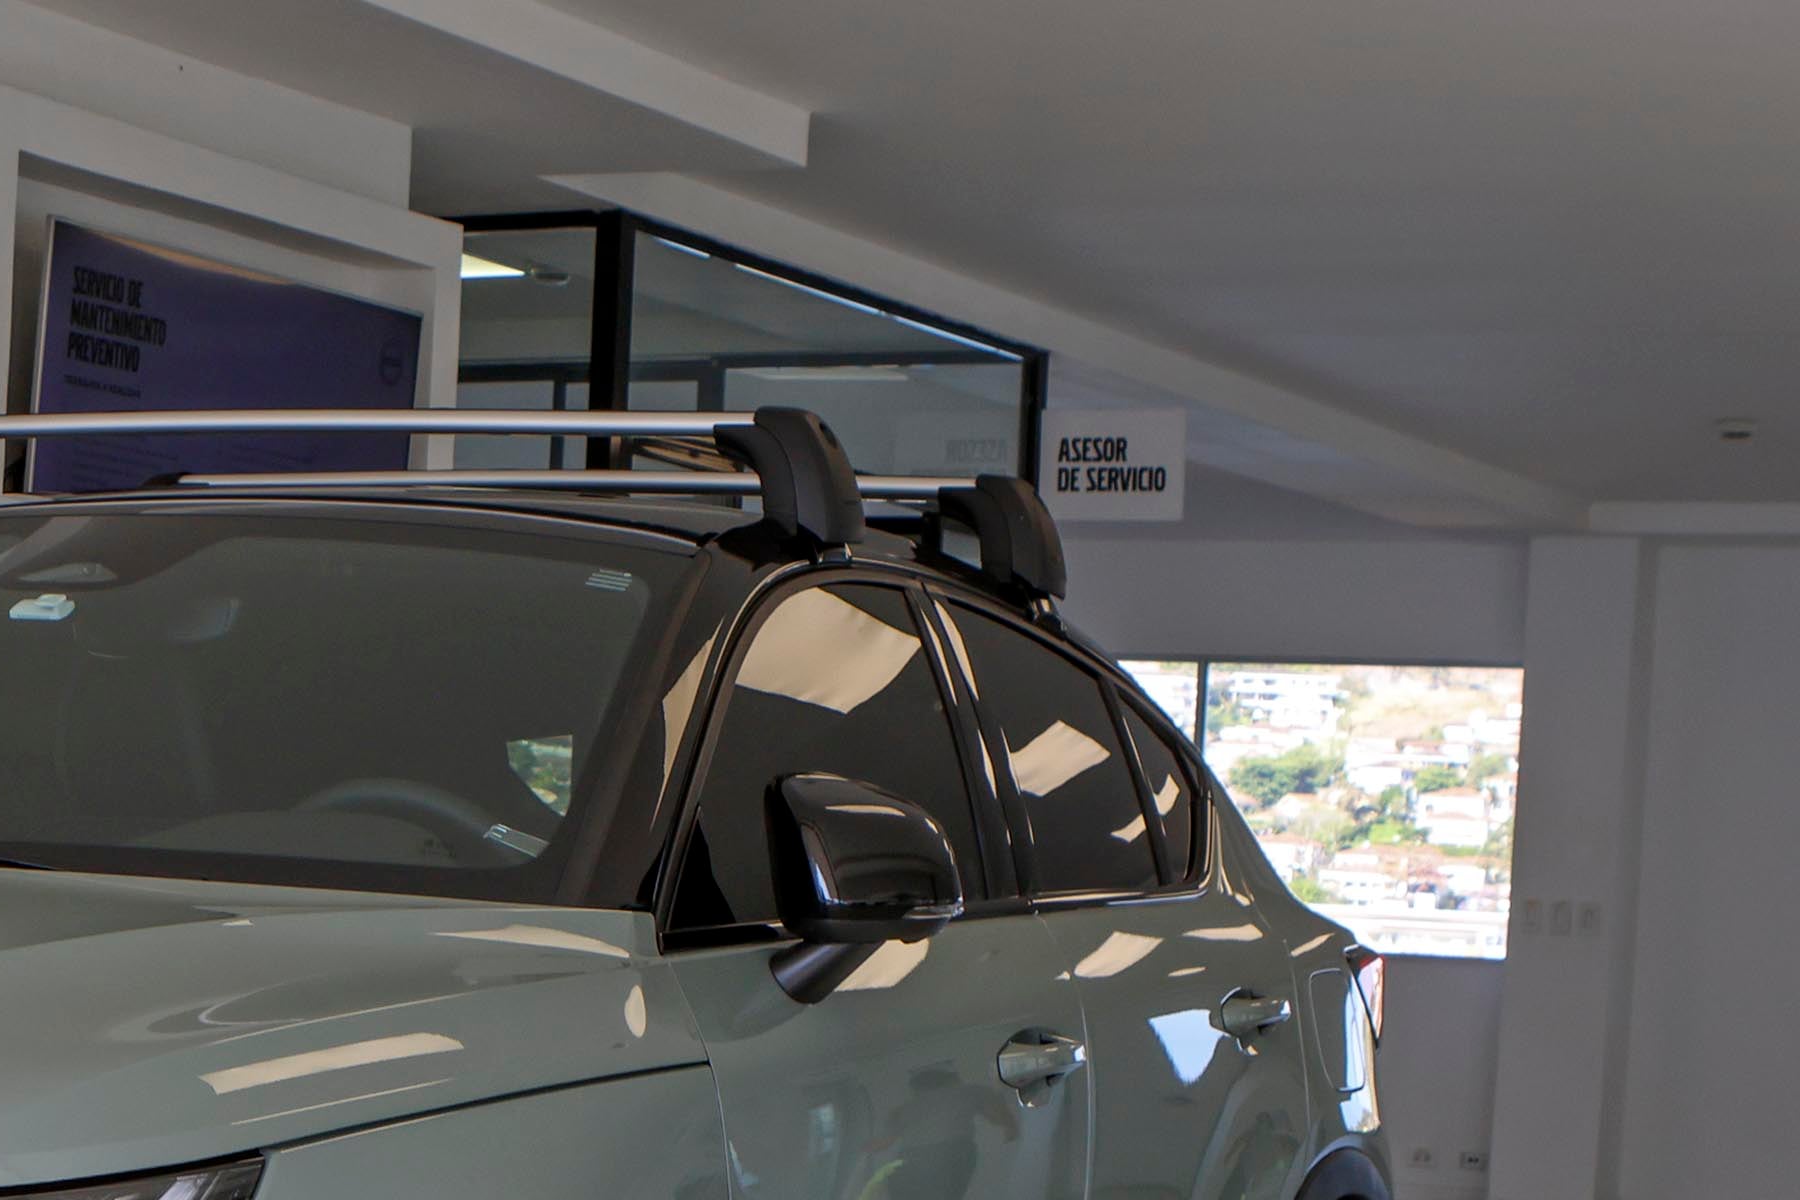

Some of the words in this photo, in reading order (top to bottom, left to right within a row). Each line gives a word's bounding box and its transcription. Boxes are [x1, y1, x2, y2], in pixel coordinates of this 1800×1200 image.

[72, 266, 125, 304] SERVICIO
[127, 280, 143, 309] DE
[69, 298, 167, 347] MANTENIMIENTO
[67, 331, 141, 373] PREVENTIVO
[1058, 437, 1128, 462] ASESOR
[1057, 467, 1080, 492] DE
[1086, 466, 1167, 492] SERVICIO
